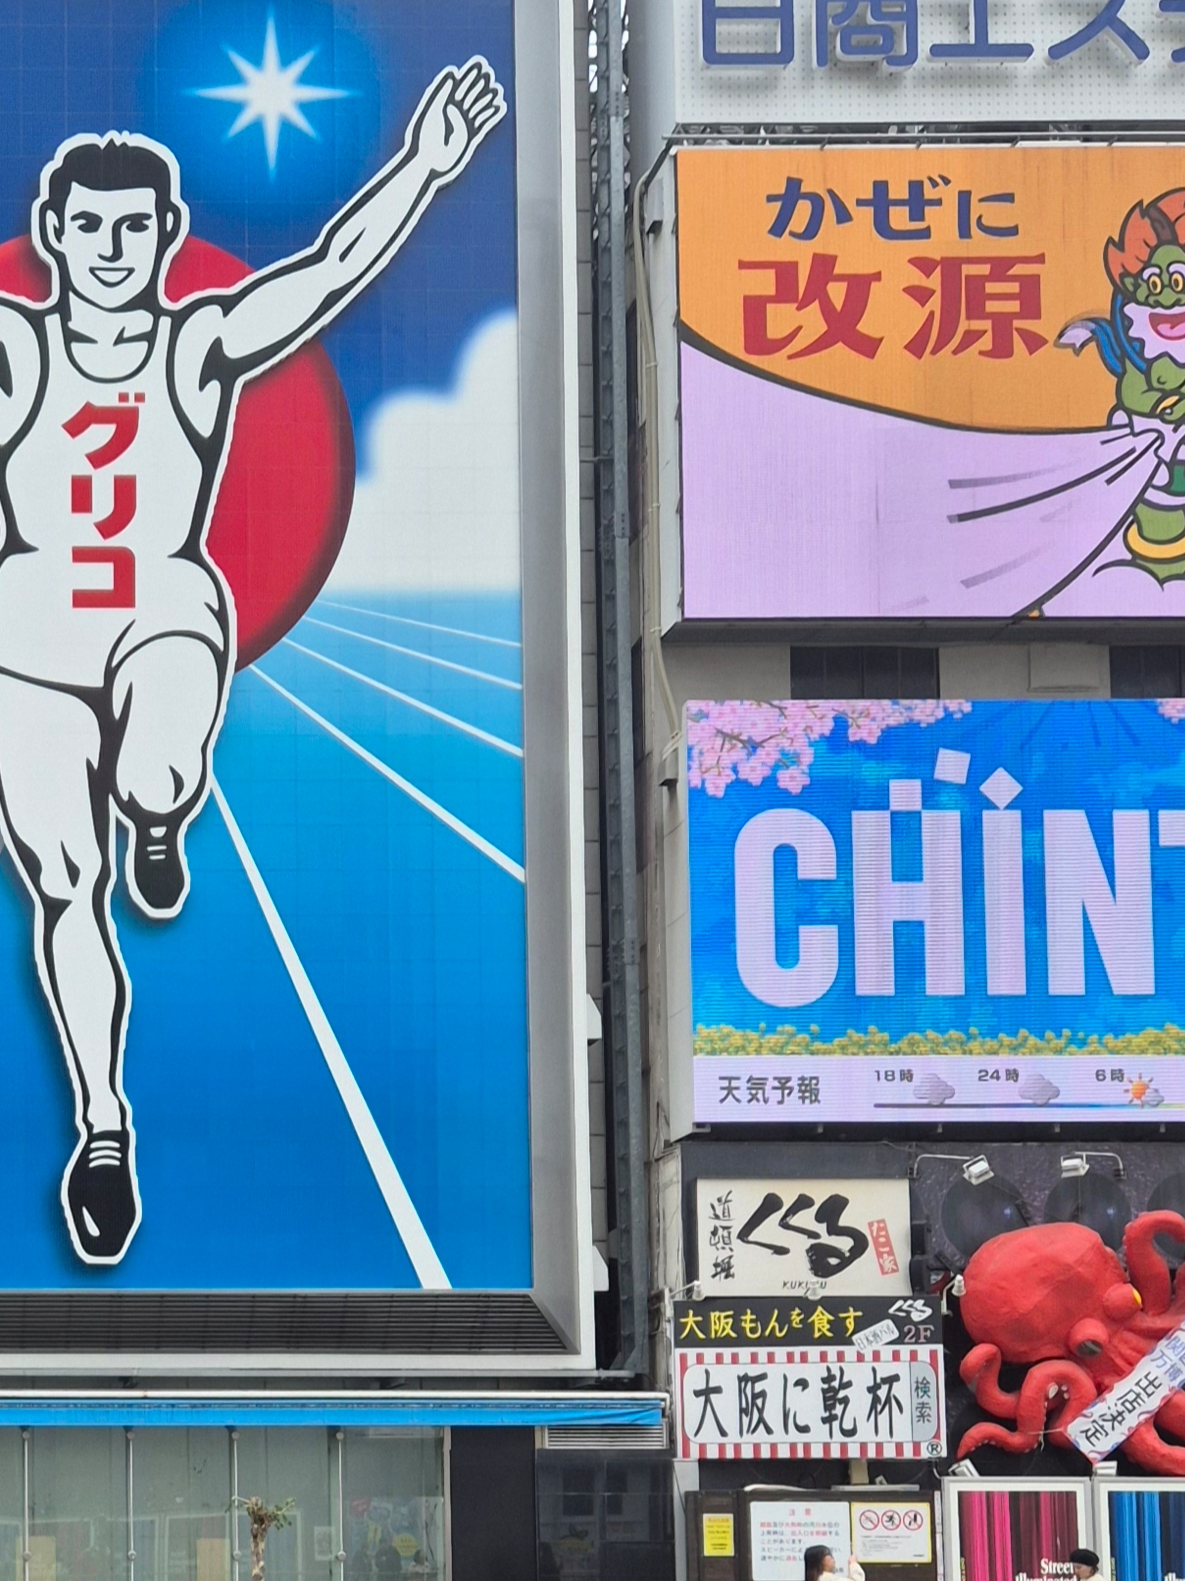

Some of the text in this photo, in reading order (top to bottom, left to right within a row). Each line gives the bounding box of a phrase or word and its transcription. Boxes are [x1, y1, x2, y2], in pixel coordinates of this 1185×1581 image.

[702, 0, 1185, 66] 日商エス
[765, 174, 1020, 242] かぜに
[737, 251, 1050, 361] 改源
[61, 391, 146, 608] グリコ
[734, 768, 1185, 1008] CHIN
[718, 1075, 821, 1105] 天気予報
[709, 1190, 735, 1280] 道頓堀
[782, 1281, 827, 1290] KUKU
[679, 1305, 863, 1341] 大阪もんを食す
[903, 1324, 935, 1343] 2F
[692, 1365, 904, 1440] 大阪に乾杯
[914, 1376, 932, 1424] 検索
[1079, 1371, 1163, 1447] 出店決定
